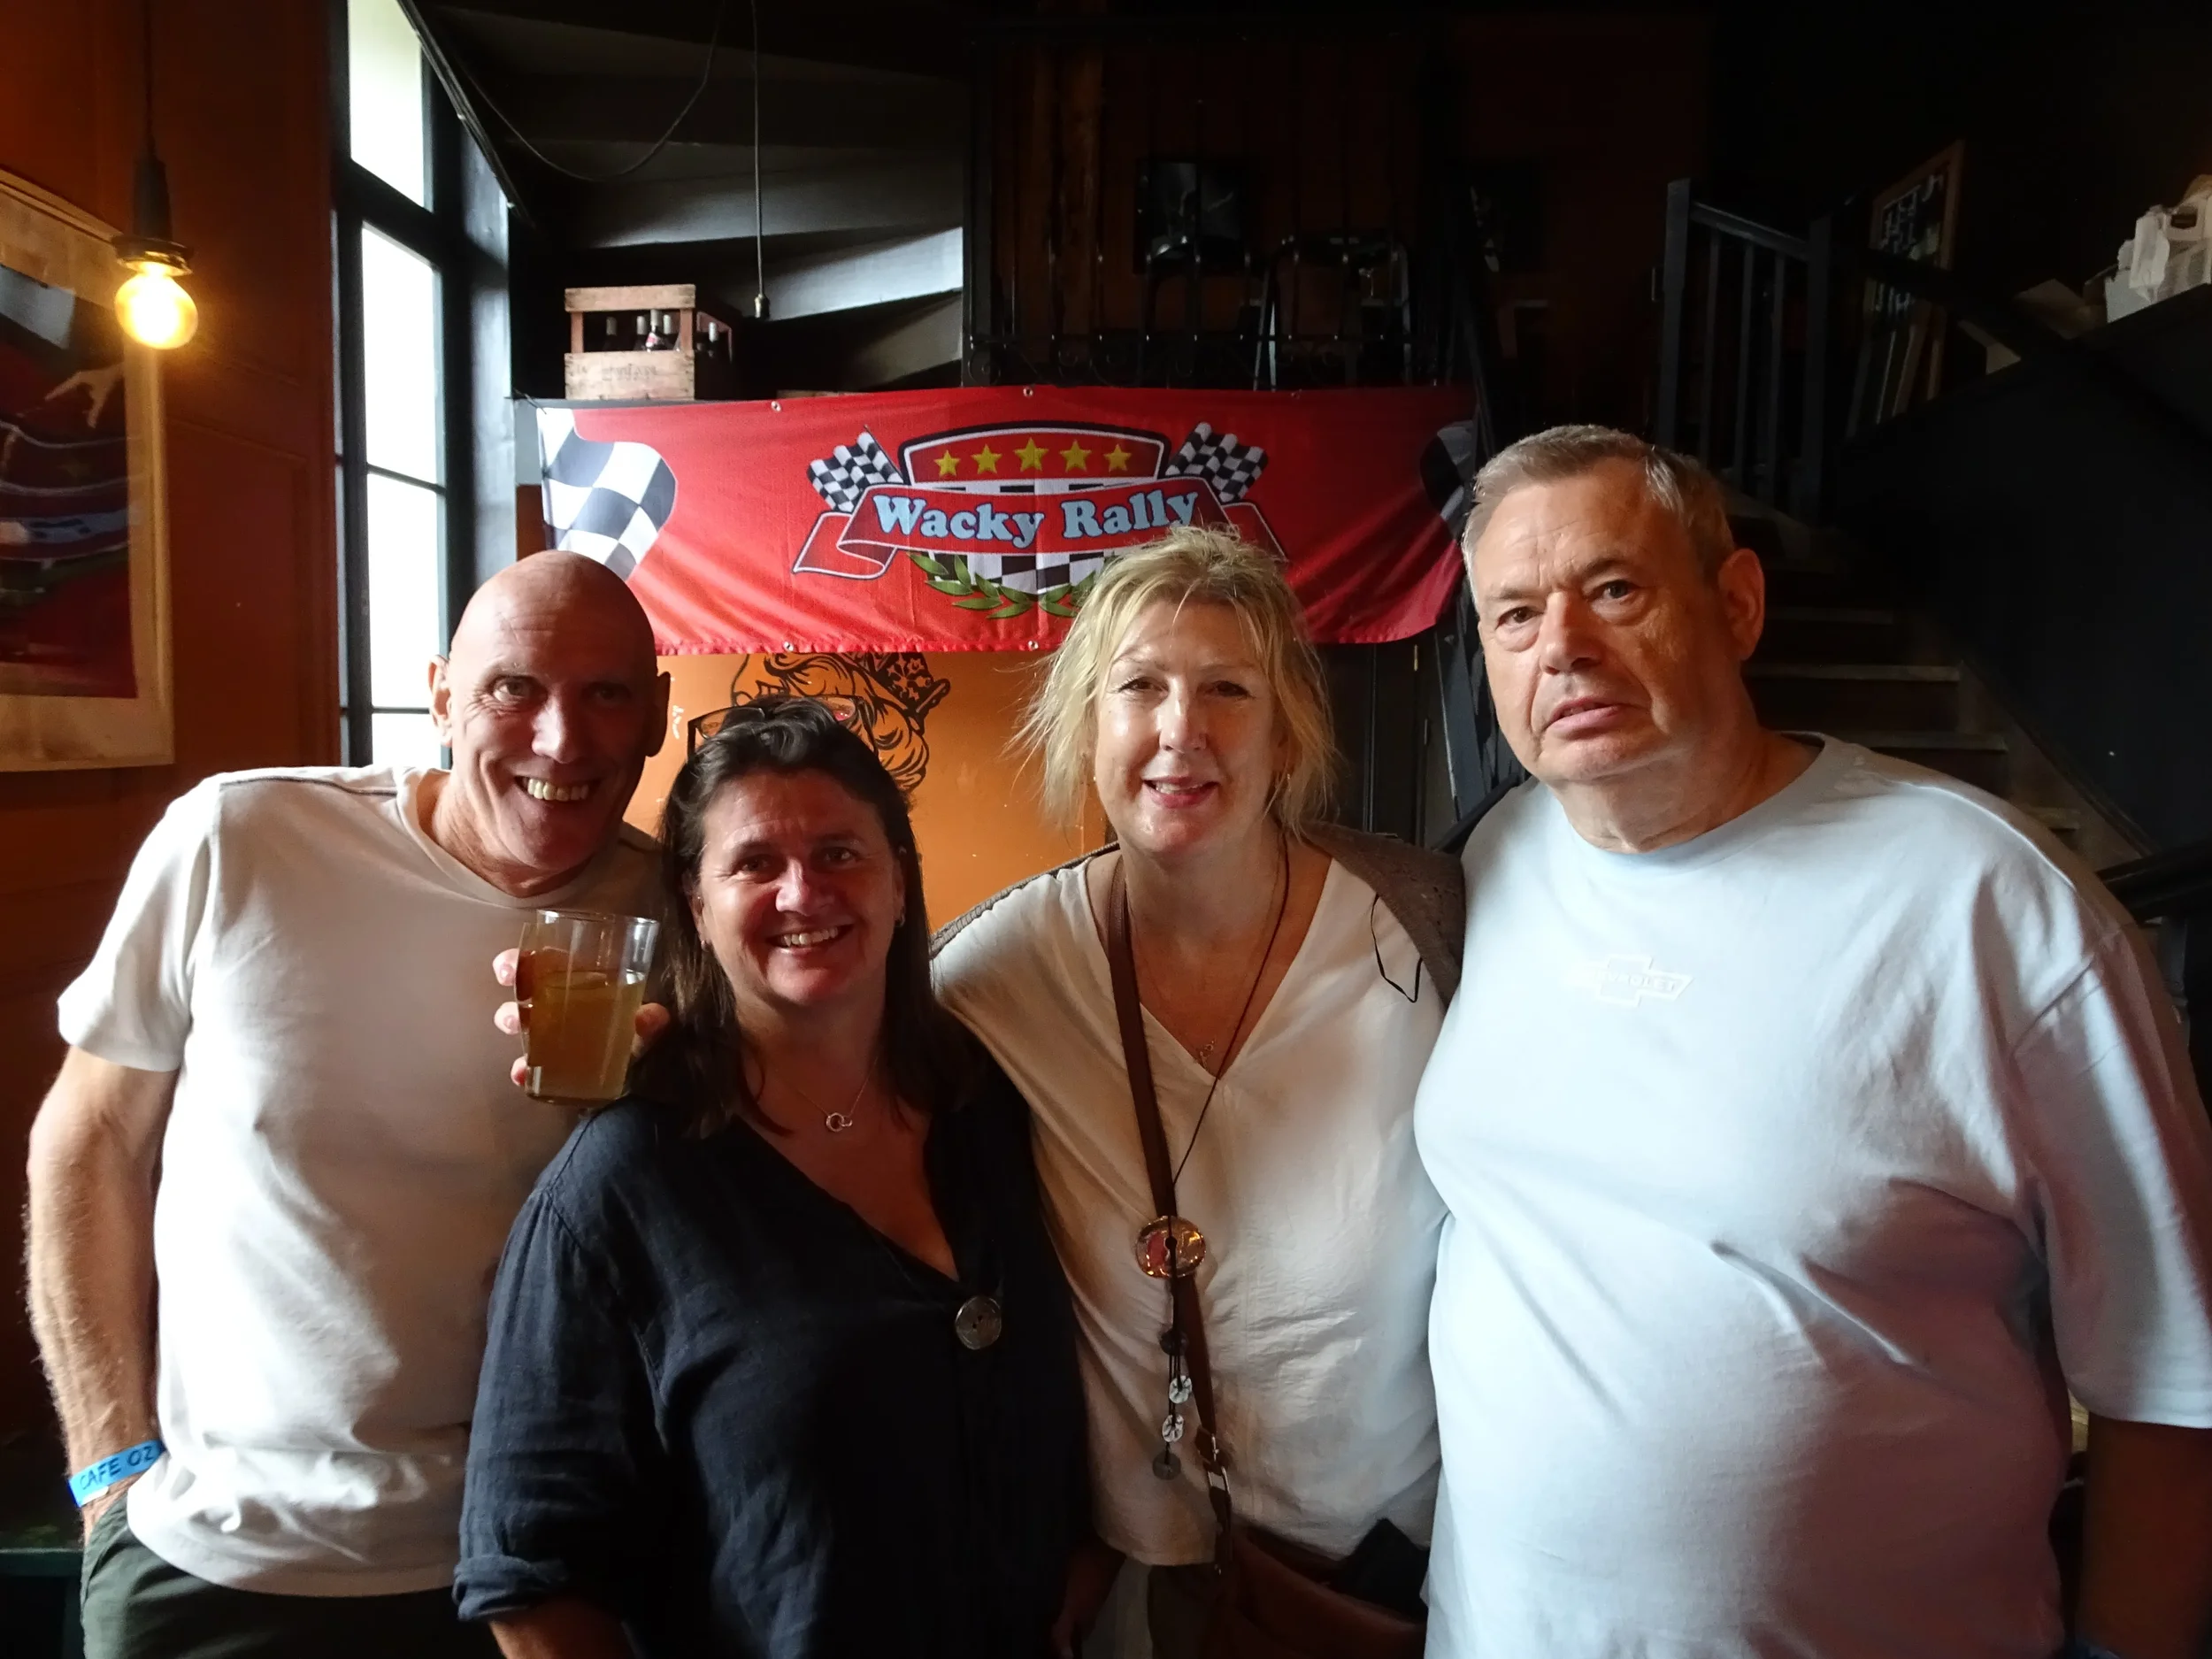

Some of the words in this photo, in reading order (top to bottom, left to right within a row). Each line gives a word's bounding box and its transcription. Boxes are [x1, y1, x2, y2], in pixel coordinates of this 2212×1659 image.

[871, 494, 1045, 549] Wacky
[1060, 489, 1199, 539] Rally
[79, 1456, 121, 1490] CAFE
